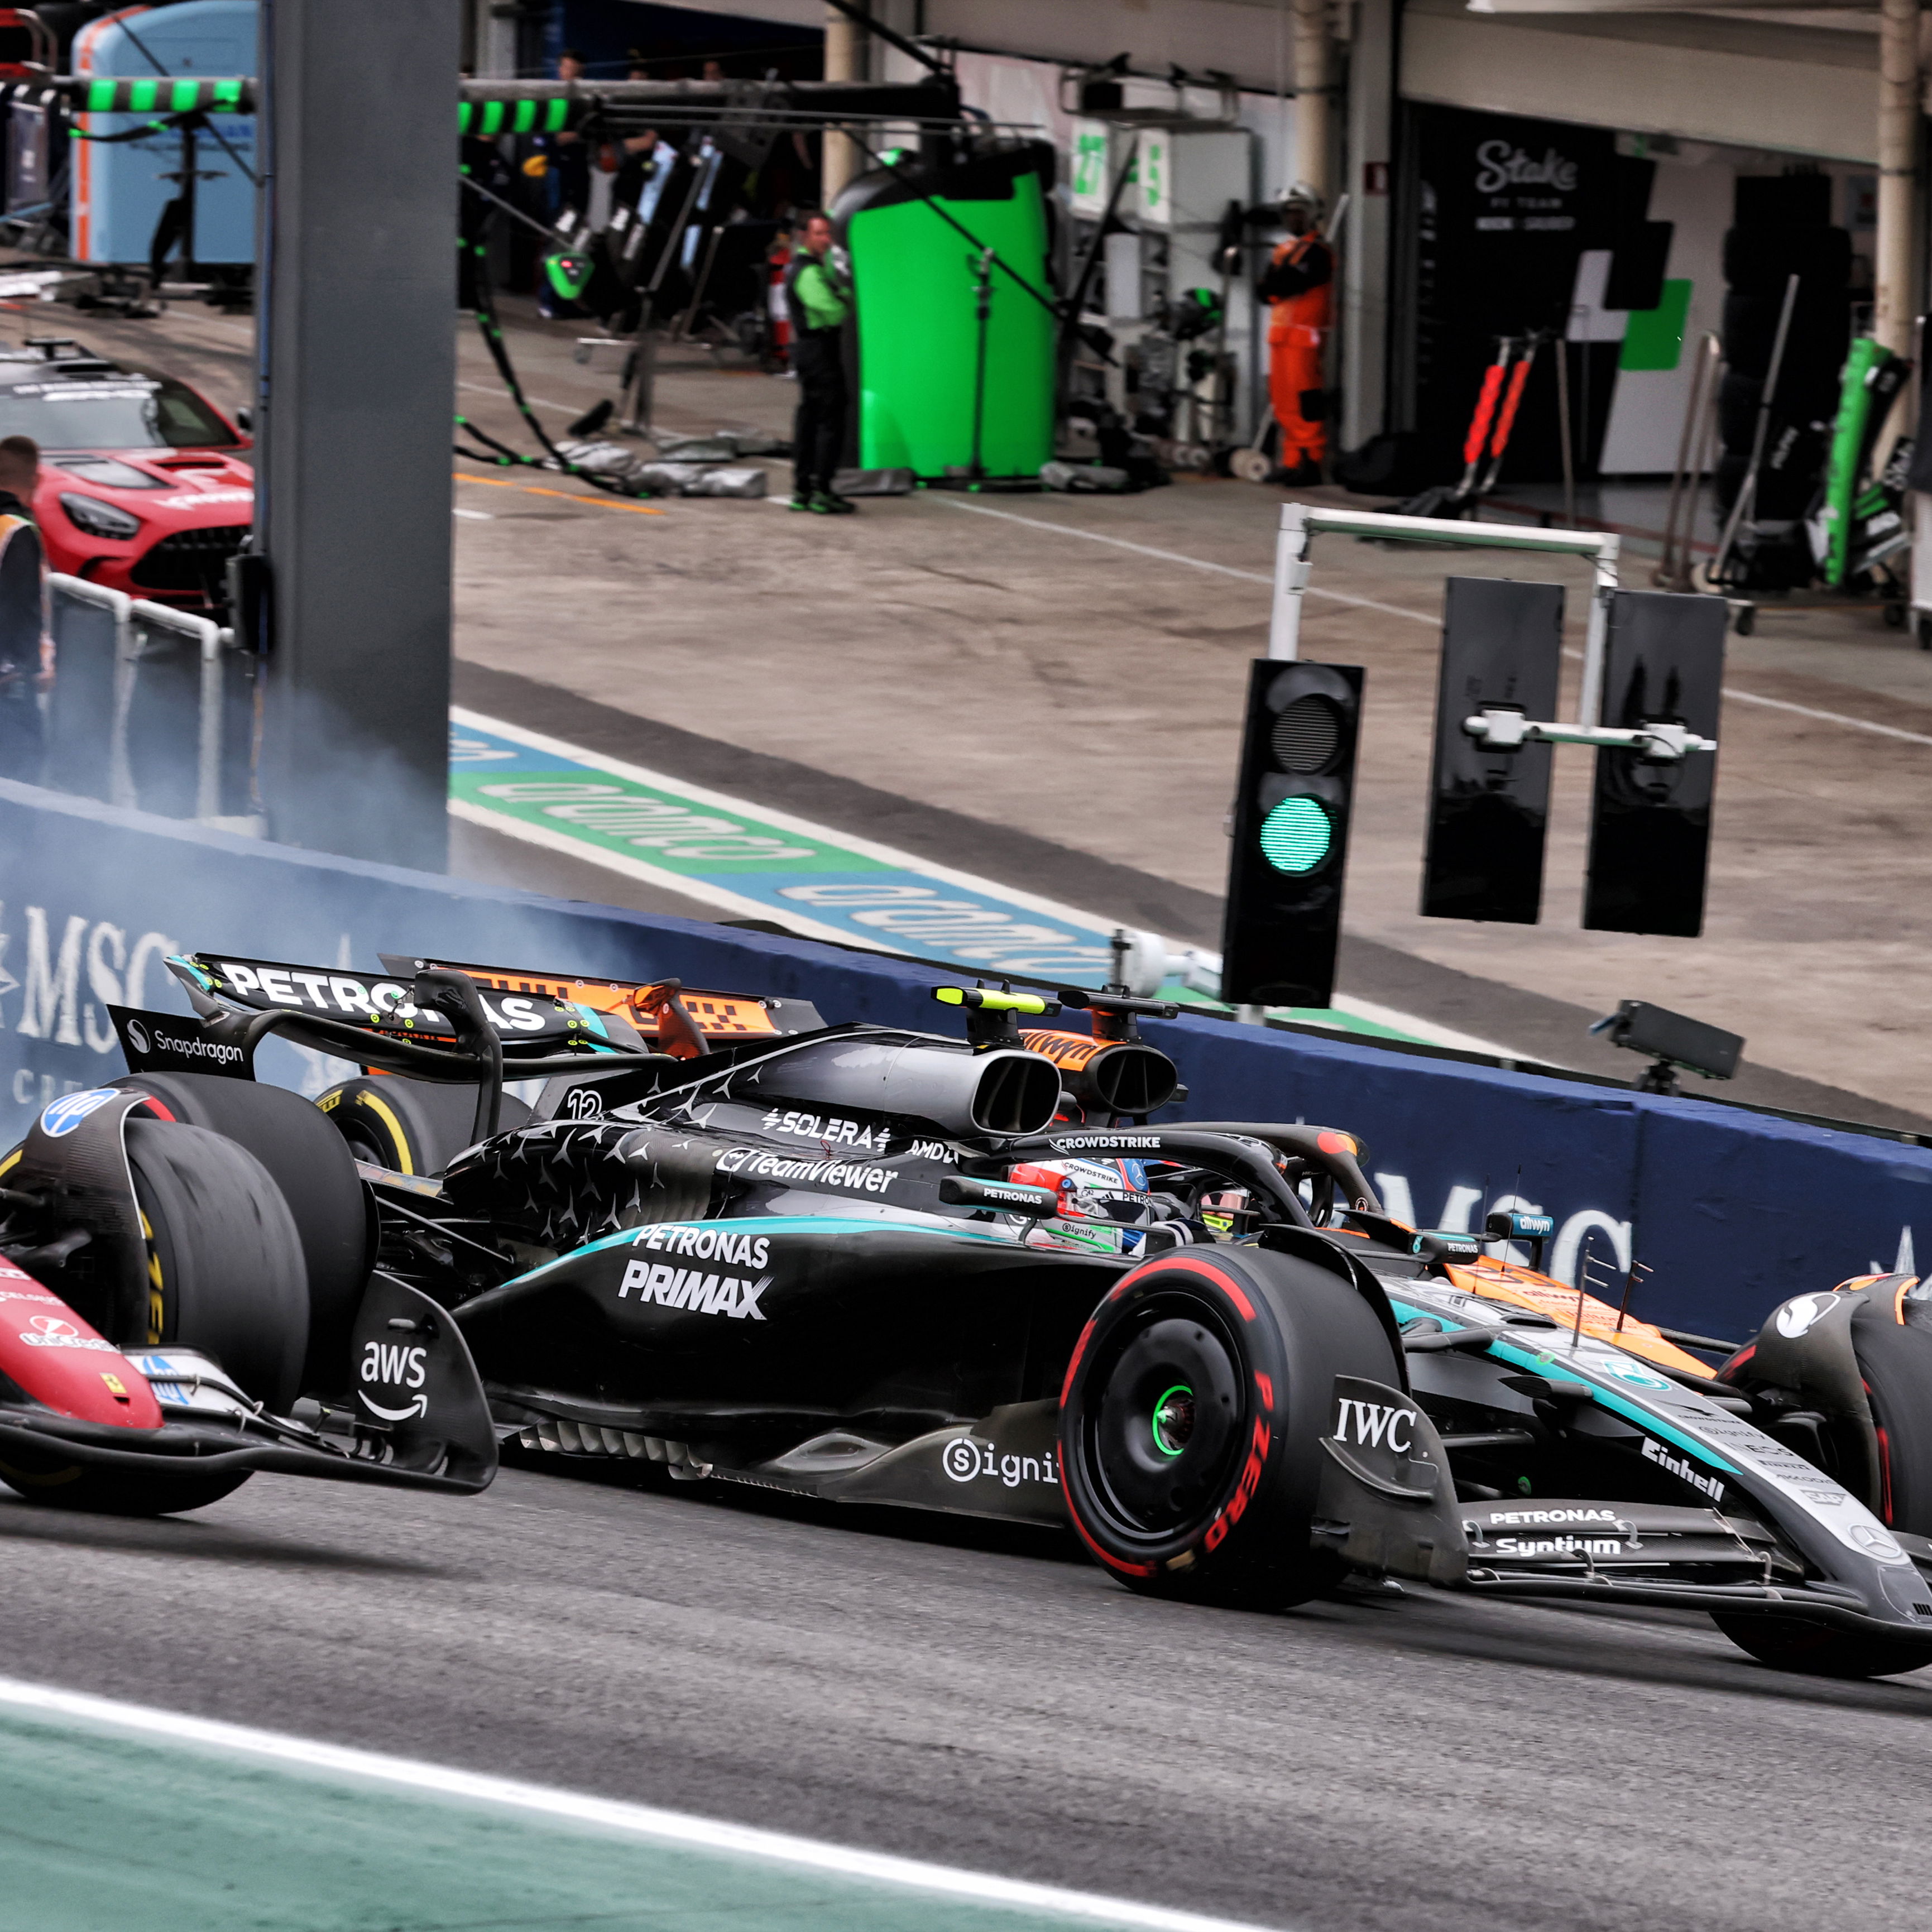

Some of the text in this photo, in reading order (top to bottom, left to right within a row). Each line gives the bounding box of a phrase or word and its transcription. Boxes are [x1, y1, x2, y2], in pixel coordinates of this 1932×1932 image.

[1475, 140, 1578, 192] Stake
[220, 963, 545, 1030] PETROAS
[155, 1030, 244, 1065] Snapdragon
[1020, 1031, 1097, 1064] llwyn
[567, 1089, 605, 1120] 12
[776, 1111, 872, 1149] SOLERA
[1056, 1137, 1161, 1149] CROWDSTRIKE
[905, 1139, 945, 1160] AMD
[747, 1151, 899, 1193] TeamViewer
[1064, 1162, 1119, 1184] CROWDSTRIKE
[984, 1188, 1043, 1205] PETRONAS
[1062, 1223, 1096, 1238] signify
[1519, 1216, 1550, 1234] allwyn
[632, 1225, 770, 1269] PETRONAS
[1447, 1243, 1478, 1254] PETRONAS
[618, 1259, 775, 1320] PRIMAX
[361, 1341, 427, 1388] aws
[1333, 1398, 1417, 1452] IWC
[942, 1438, 1060, 1487] signi
[1724, 1443, 1794, 1456] INEOS
[1641, 1437, 1725, 1502] Einhell
[1805, 1489, 1843, 1506] SAP
[1489, 1509, 1617, 1524] PETRONAS
[1495, 1535, 1621, 1557] Syntium
